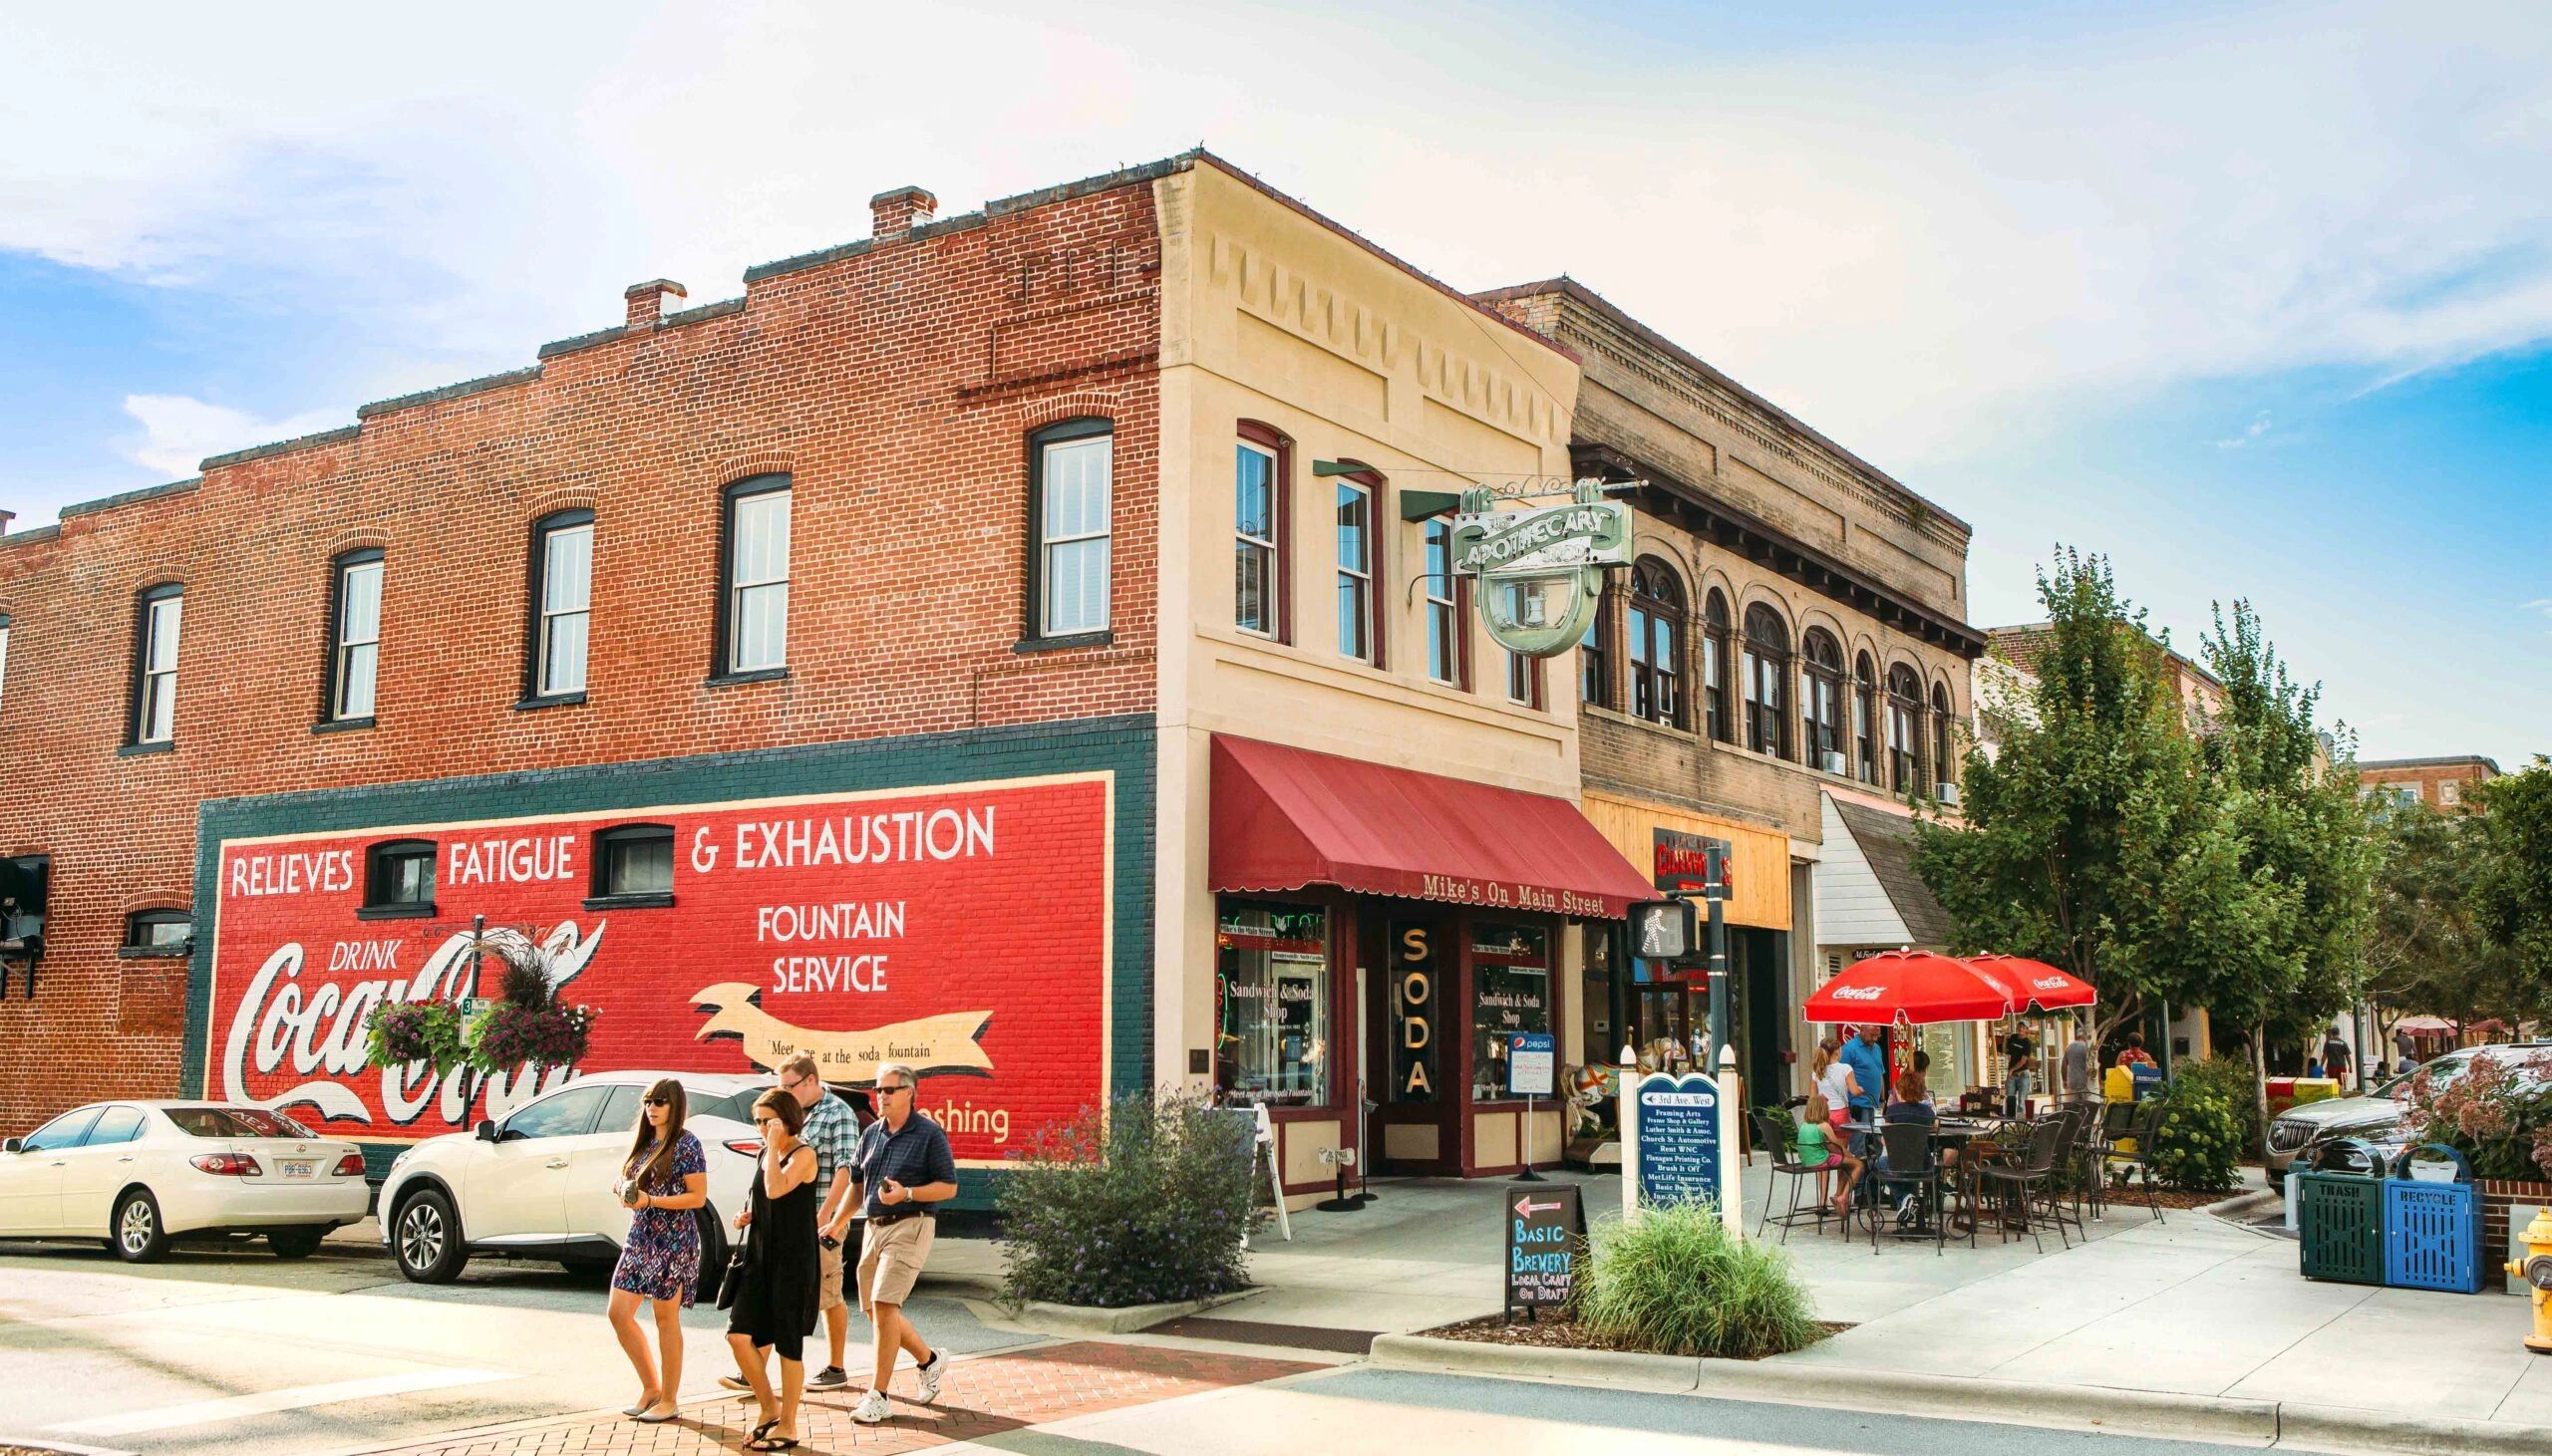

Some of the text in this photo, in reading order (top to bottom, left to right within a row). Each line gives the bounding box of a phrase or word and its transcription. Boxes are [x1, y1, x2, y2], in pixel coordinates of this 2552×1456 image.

[1467, 510, 1610, 565] APOTHECARY
[232, 805, 995, 897] RELIEVES FATIGUE & EXHAUSTION
[1424, 874, 1604, 913] Mike's On Main Street
[758, 901, 905, 942] FOUNTAIN
[329, 940, 404, 971] DRINK
[773, 955, 888, 994] SERVICE
[1230, 981, 1315, 1001] Sandwich & Soda
[464, 1001, 472, 1013] 3
[1479, 992, 1540, 1009] Sandwich & Soda
[1264, 1004, 1288, 1021] Shop
[1404, 928, 1432, 1093] SODA
[1502, 1011, 1520, 1027] Shop
[1526, 1039, 1550, 1049] pepsi
[822, 1049, 831, 1063] at
[835, 1048, 851, 1063] the
[858, 1046, 880, 1061] soda
[1659, 1094, 1711, 1105] 3rd Ave. West
[1656, 1109, 1685, 1118] Framing
[1666, 1117, 1681, 1126] Shop
[1688, 1118, 1710, 1127] Gallery
[1678, 1136, 1717, 1145] Automotive
[1675, 1155, 1701, 1165] Printing
[1677, 1174, 1712, 1184] Insurance
[2319, 1183, 2361, 1198] TRASH
[2399, 1189, 2457, 1207] RECYCLE
[1515, 1219, 1565, 1244] BASIC
[1512, 1246, 1572, 1274] BREWERY
[1511, 1272, 1571, 1287] LOCAL CRAFT
[1538, 1286, 1568, 1301] DRAFT
